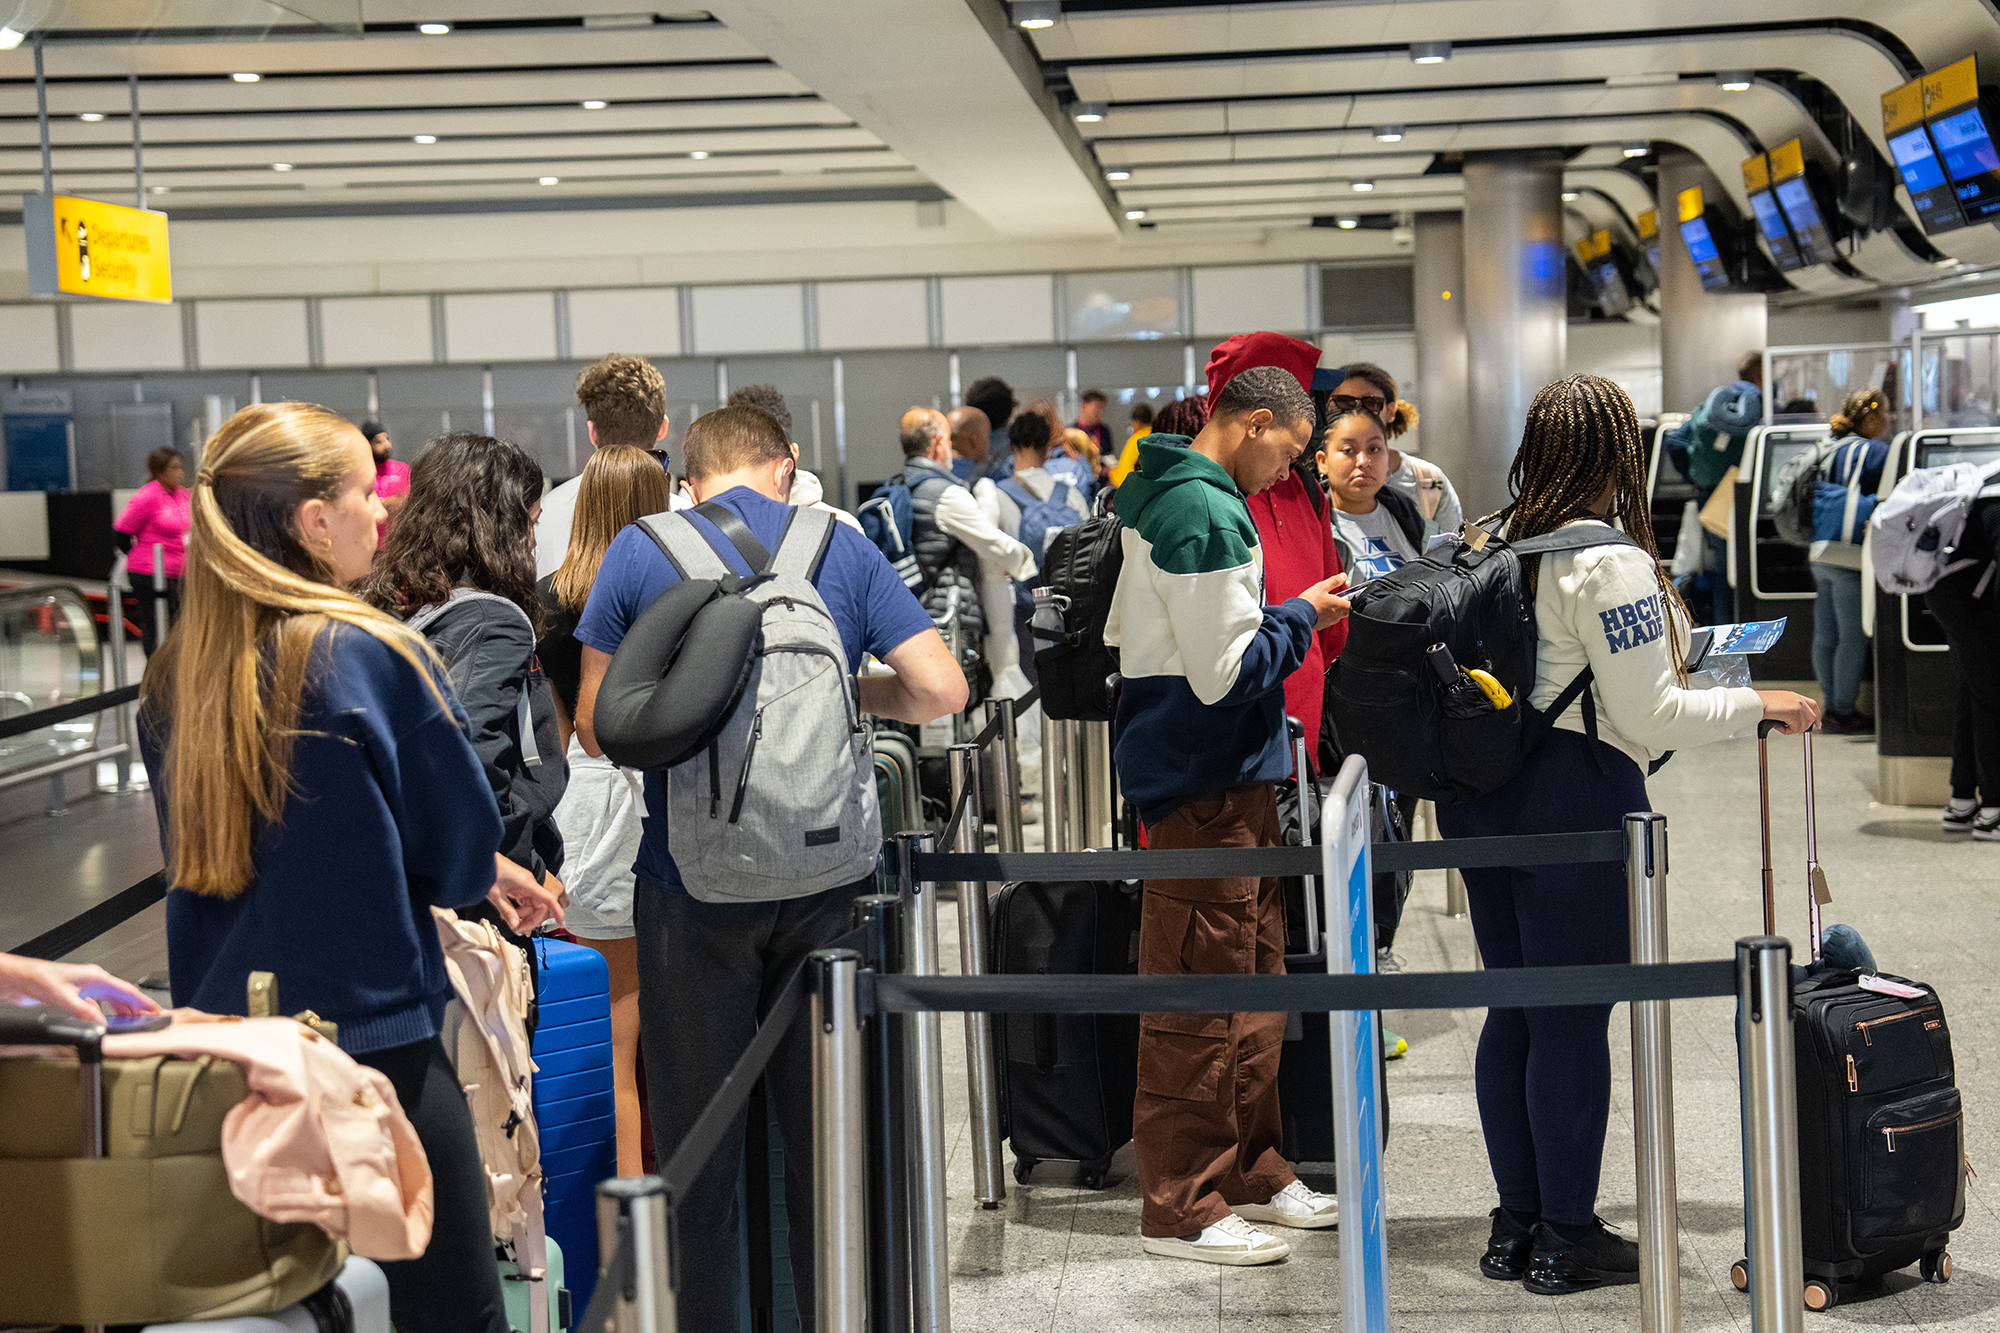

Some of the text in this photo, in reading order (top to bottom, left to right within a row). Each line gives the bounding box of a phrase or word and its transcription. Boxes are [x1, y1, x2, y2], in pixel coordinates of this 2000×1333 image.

[92, 222, 151, 255] Departures
[94, 255, 137, 290] Security
[1598, 594, 1660, 634] HBCU
